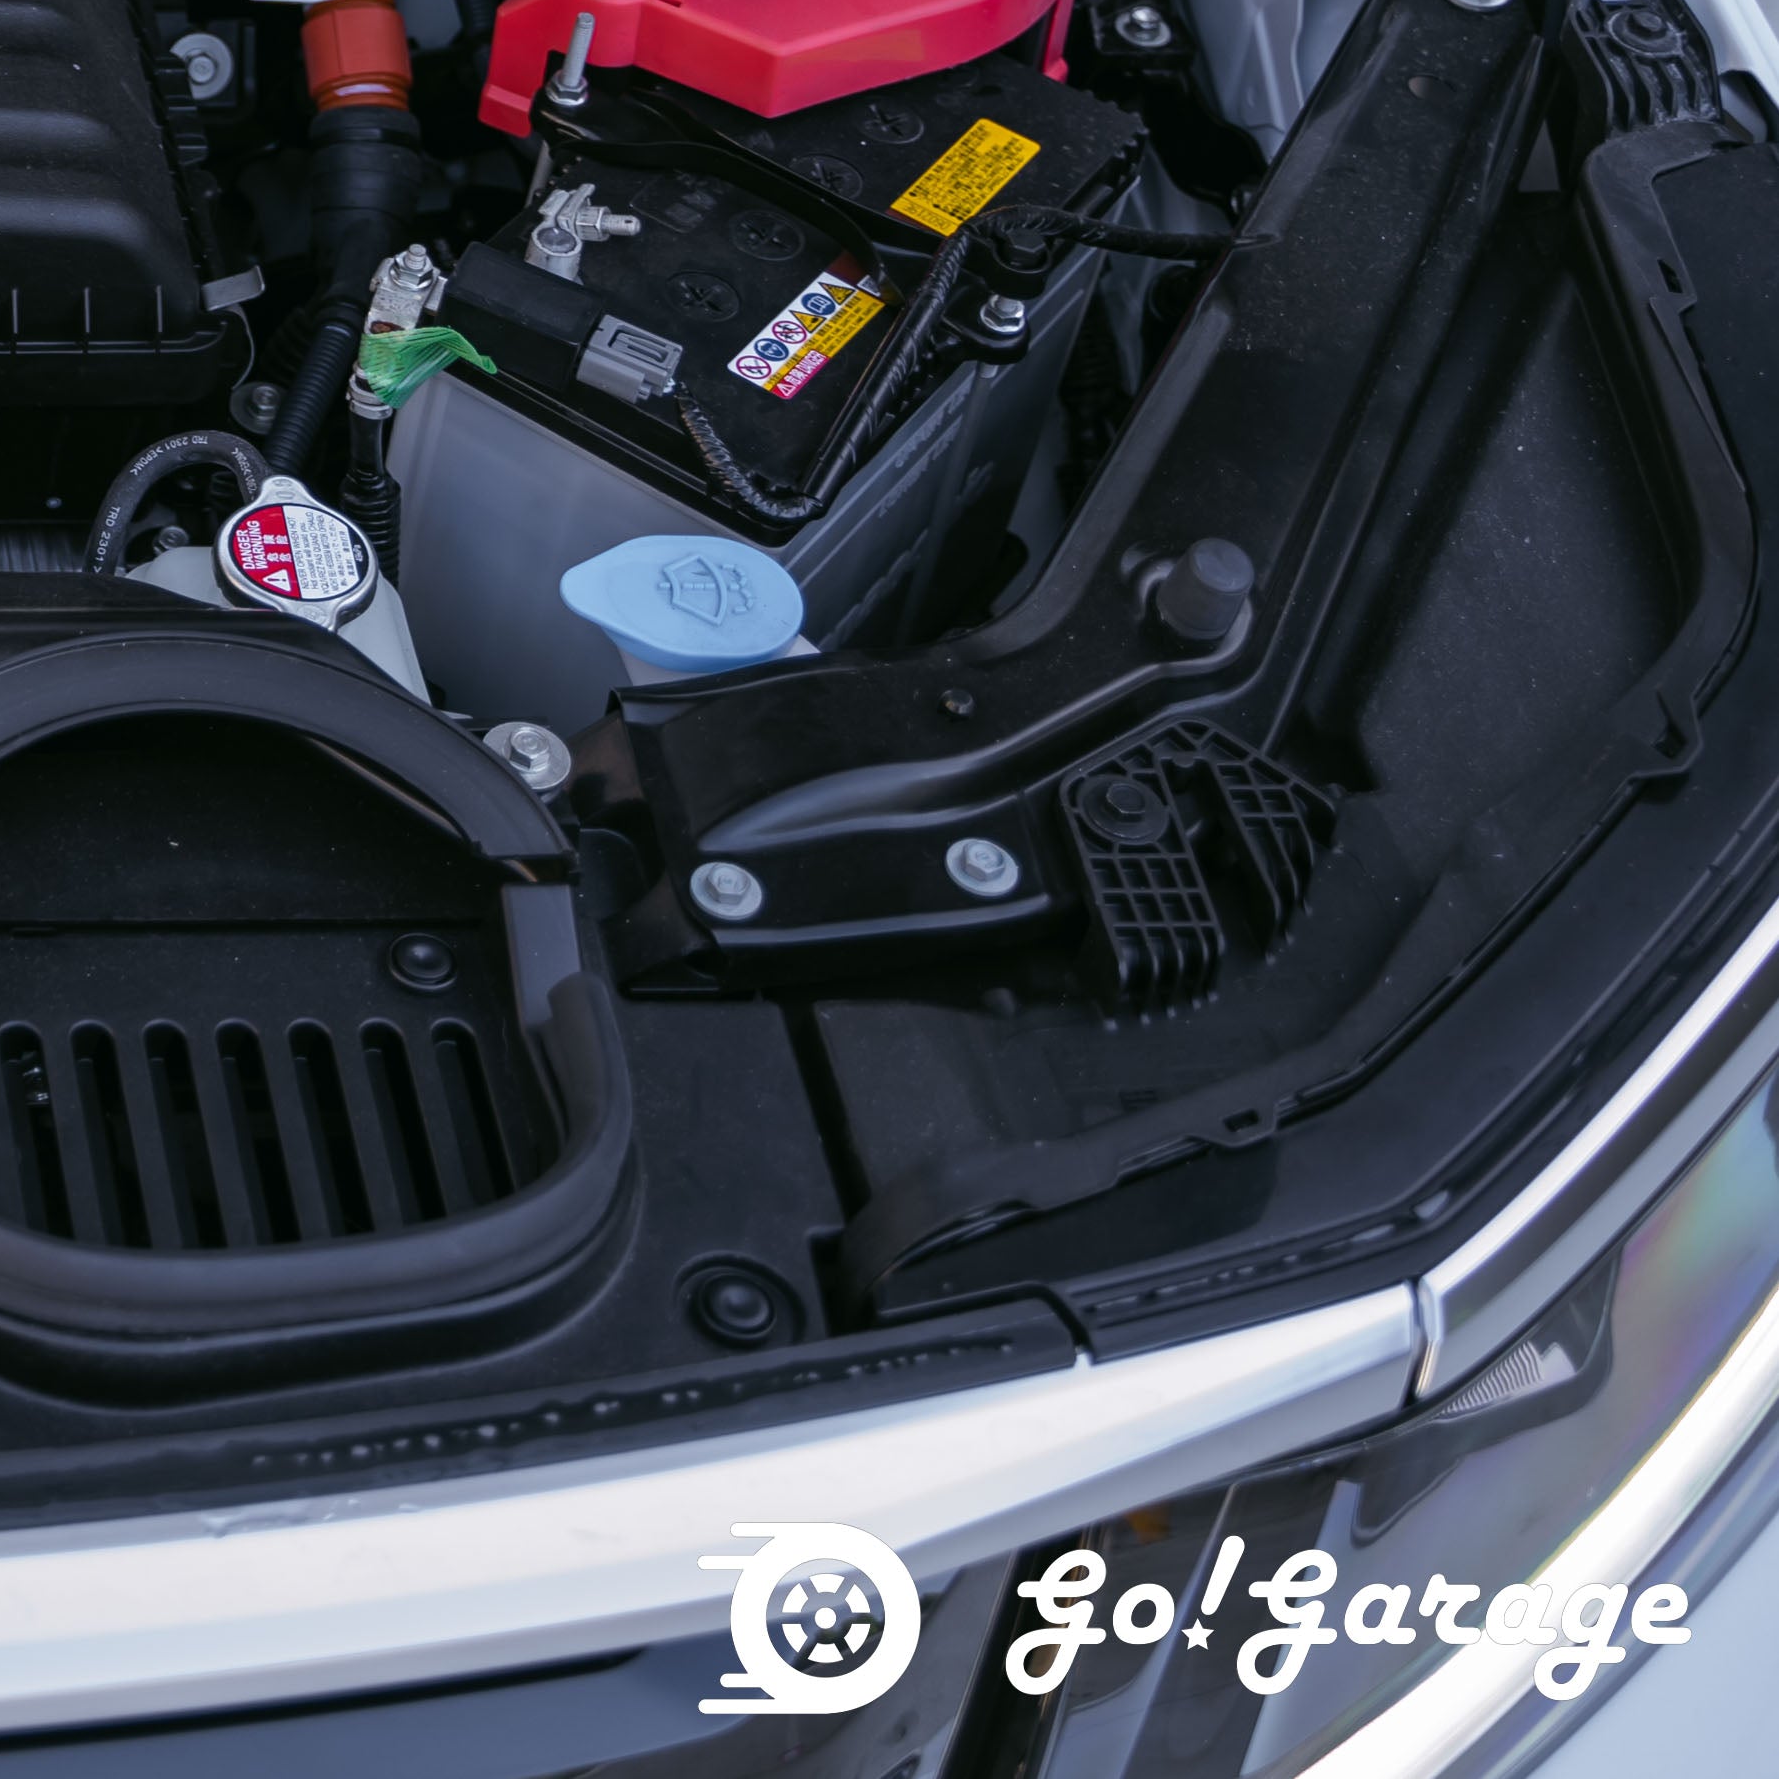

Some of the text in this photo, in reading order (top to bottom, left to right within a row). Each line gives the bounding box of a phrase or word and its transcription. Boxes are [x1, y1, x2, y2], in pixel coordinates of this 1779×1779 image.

[105, 506, 121, 527] TRD
[236, 529, 256, 570] DANGER
[246, 520, 268, 570] WARNUNG
[287, 516, 309, 589] NEVER OPEN WHEN HOT
[310, 532, 321, 552] QUAND
[314, 553, 323, 565] PAS
